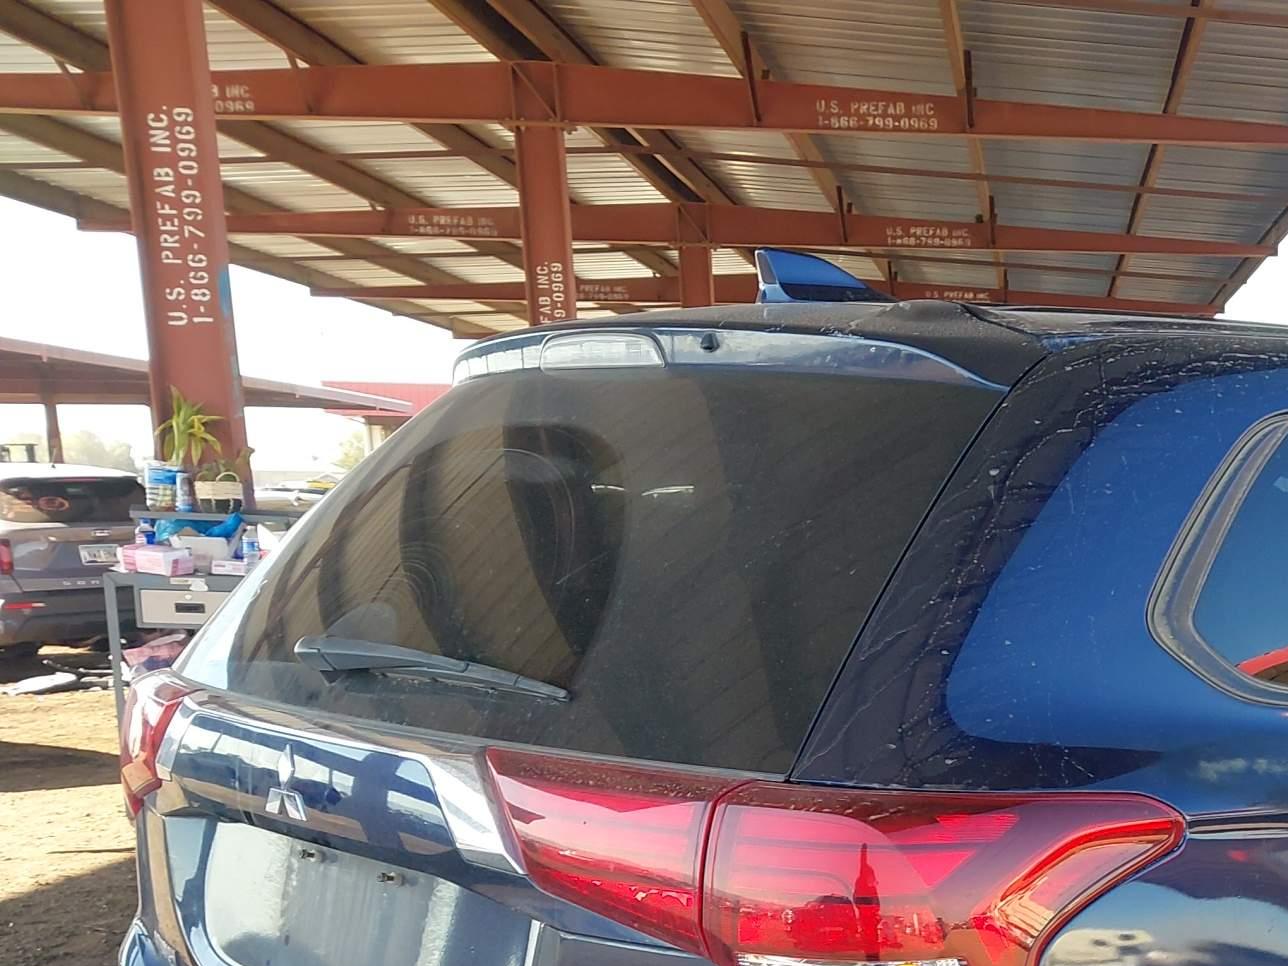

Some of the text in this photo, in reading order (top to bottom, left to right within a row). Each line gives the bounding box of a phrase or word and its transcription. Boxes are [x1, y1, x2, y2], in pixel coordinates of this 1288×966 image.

[816, 100, 842, 114] U.S.
[850, 101, 905, 115] PREFAB
[147, 105, 189, 326] U.S. PREFAB INC.
[172, 107, 214, 324] 1-866-799-0969
[910, 226, 948, 237] PREFAB
[536, 261, 550, 289] INC.
